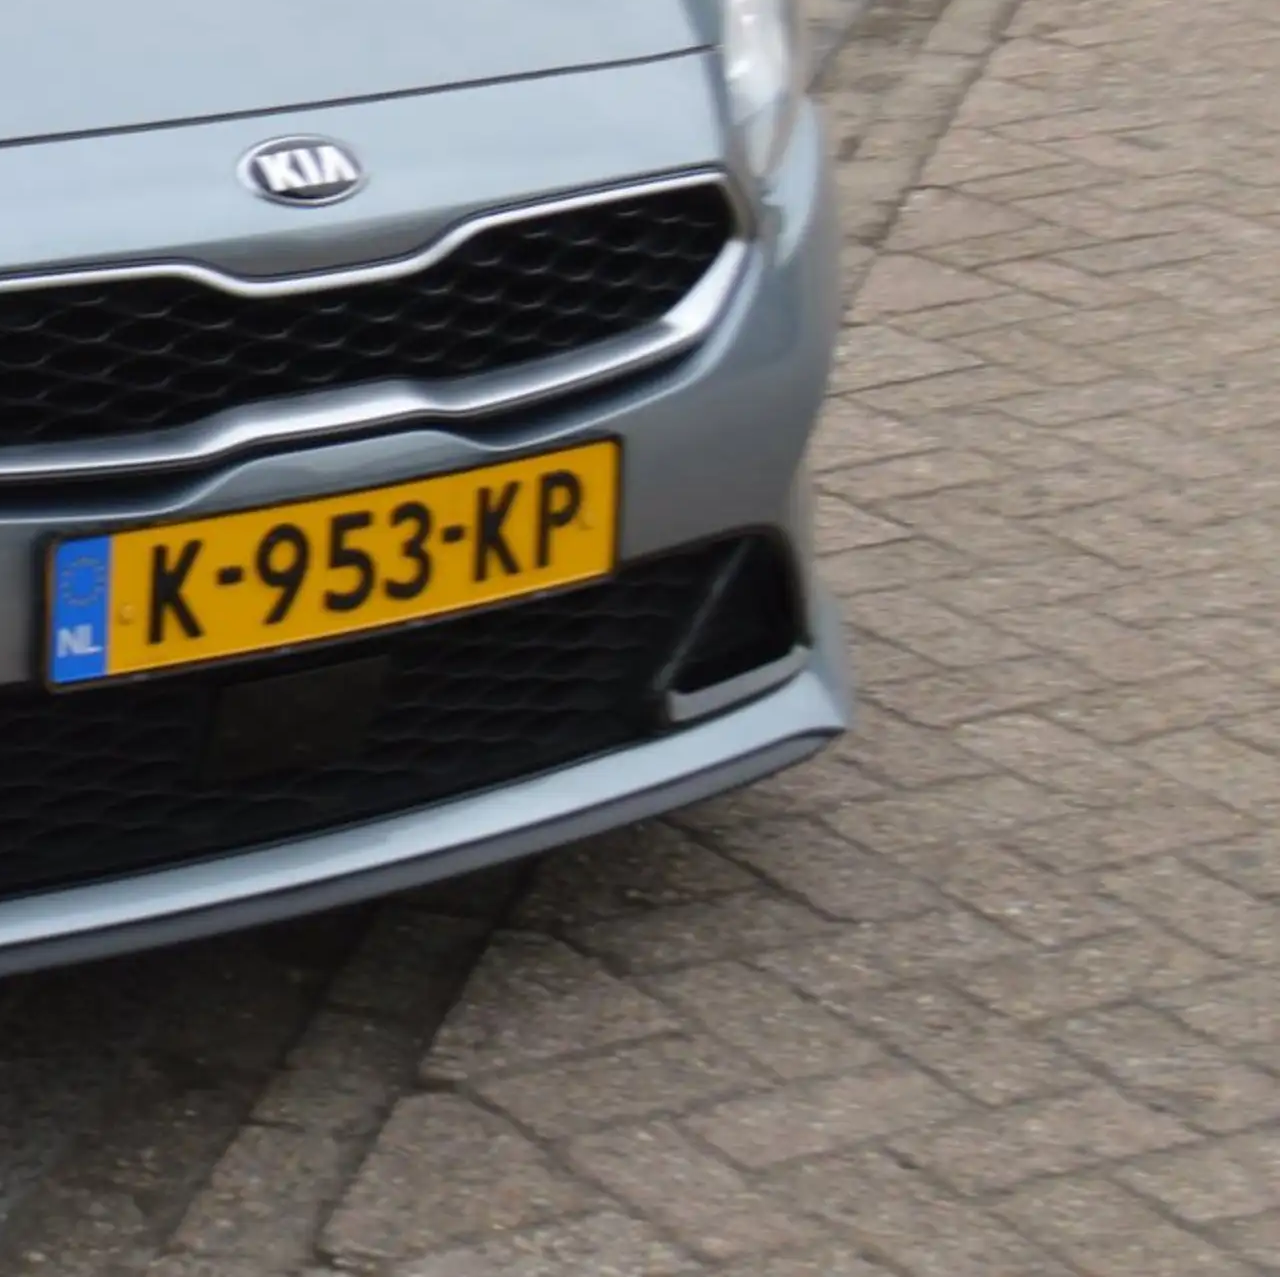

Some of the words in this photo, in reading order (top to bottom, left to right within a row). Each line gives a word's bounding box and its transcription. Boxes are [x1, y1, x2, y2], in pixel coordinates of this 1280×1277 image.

[255, 145, 358, 191] KIA
[147, 469, 582, 644] K-953-KP
[56, 625, 104, 658] NL
